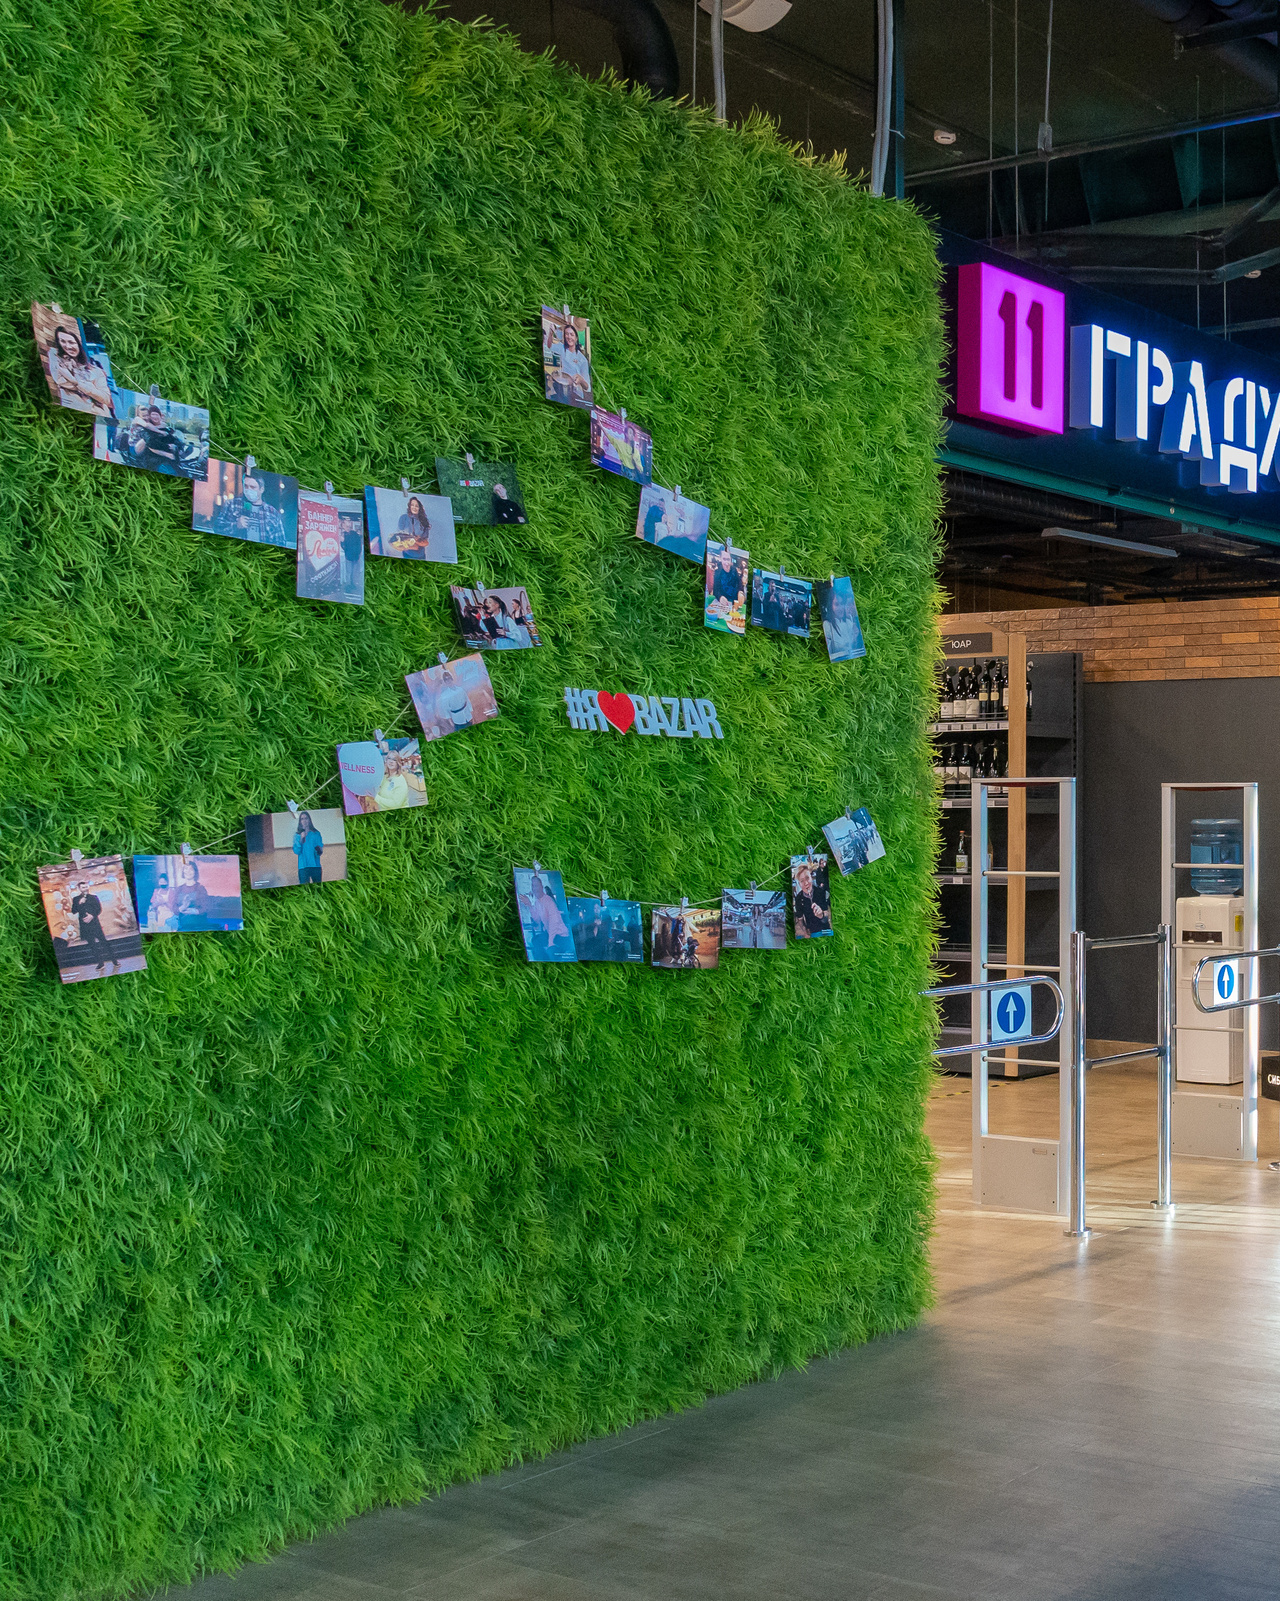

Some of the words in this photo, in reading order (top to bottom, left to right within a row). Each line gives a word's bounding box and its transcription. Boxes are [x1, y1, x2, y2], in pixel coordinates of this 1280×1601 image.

[998, 290, 1045, 410] 11
[307, 510, 334, 524] БАННЕР
[304, 521, 338, 533] ЗАРЯЖЕН
[951, 640, 972, 649] ЮАР
